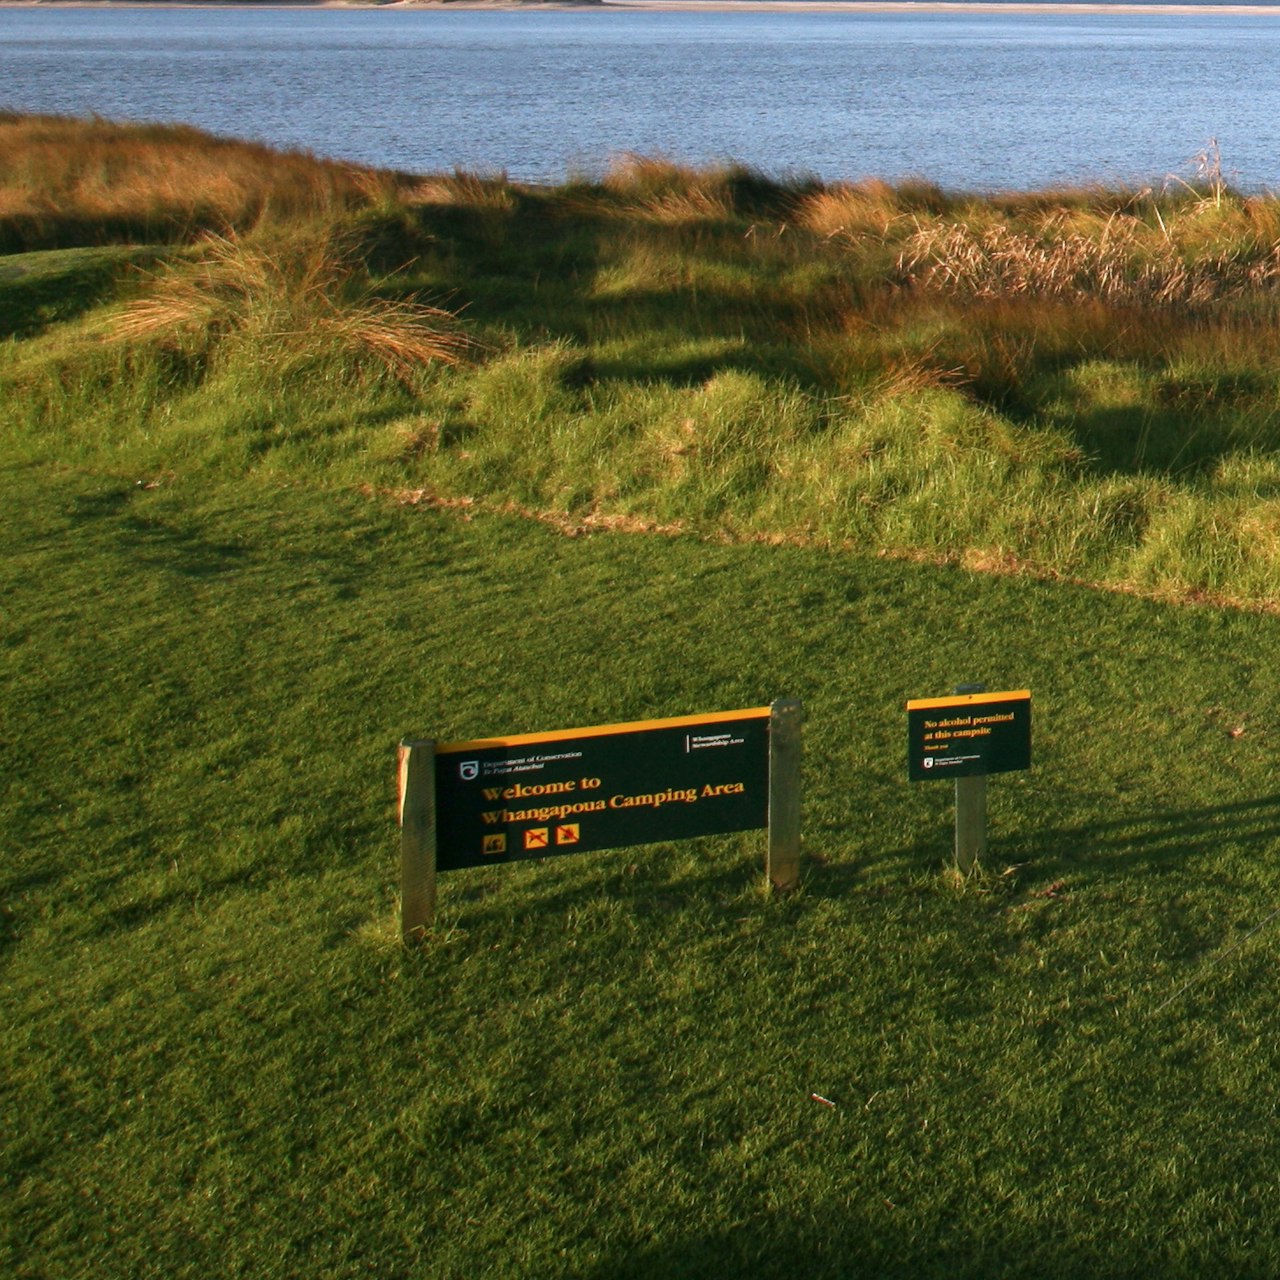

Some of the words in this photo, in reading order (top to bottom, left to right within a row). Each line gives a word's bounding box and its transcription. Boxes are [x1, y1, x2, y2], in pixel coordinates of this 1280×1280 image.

[924, 720, 937, 729] No
[938, 716, 971, 727] alcohol
[973, 712, 1014, 726] permitted
[924, 732, 933, 741] at
[935, 729, 951, 739] this
[953, 727, 992, 738] campsite
[482, 780, 576, 801] Welcome
[580, 777, 601, 789] to
[481, 799, 607, 824] Whangapoua
[609, 787, 698, 808] Camping
[701, 782, 745, 797] Area
